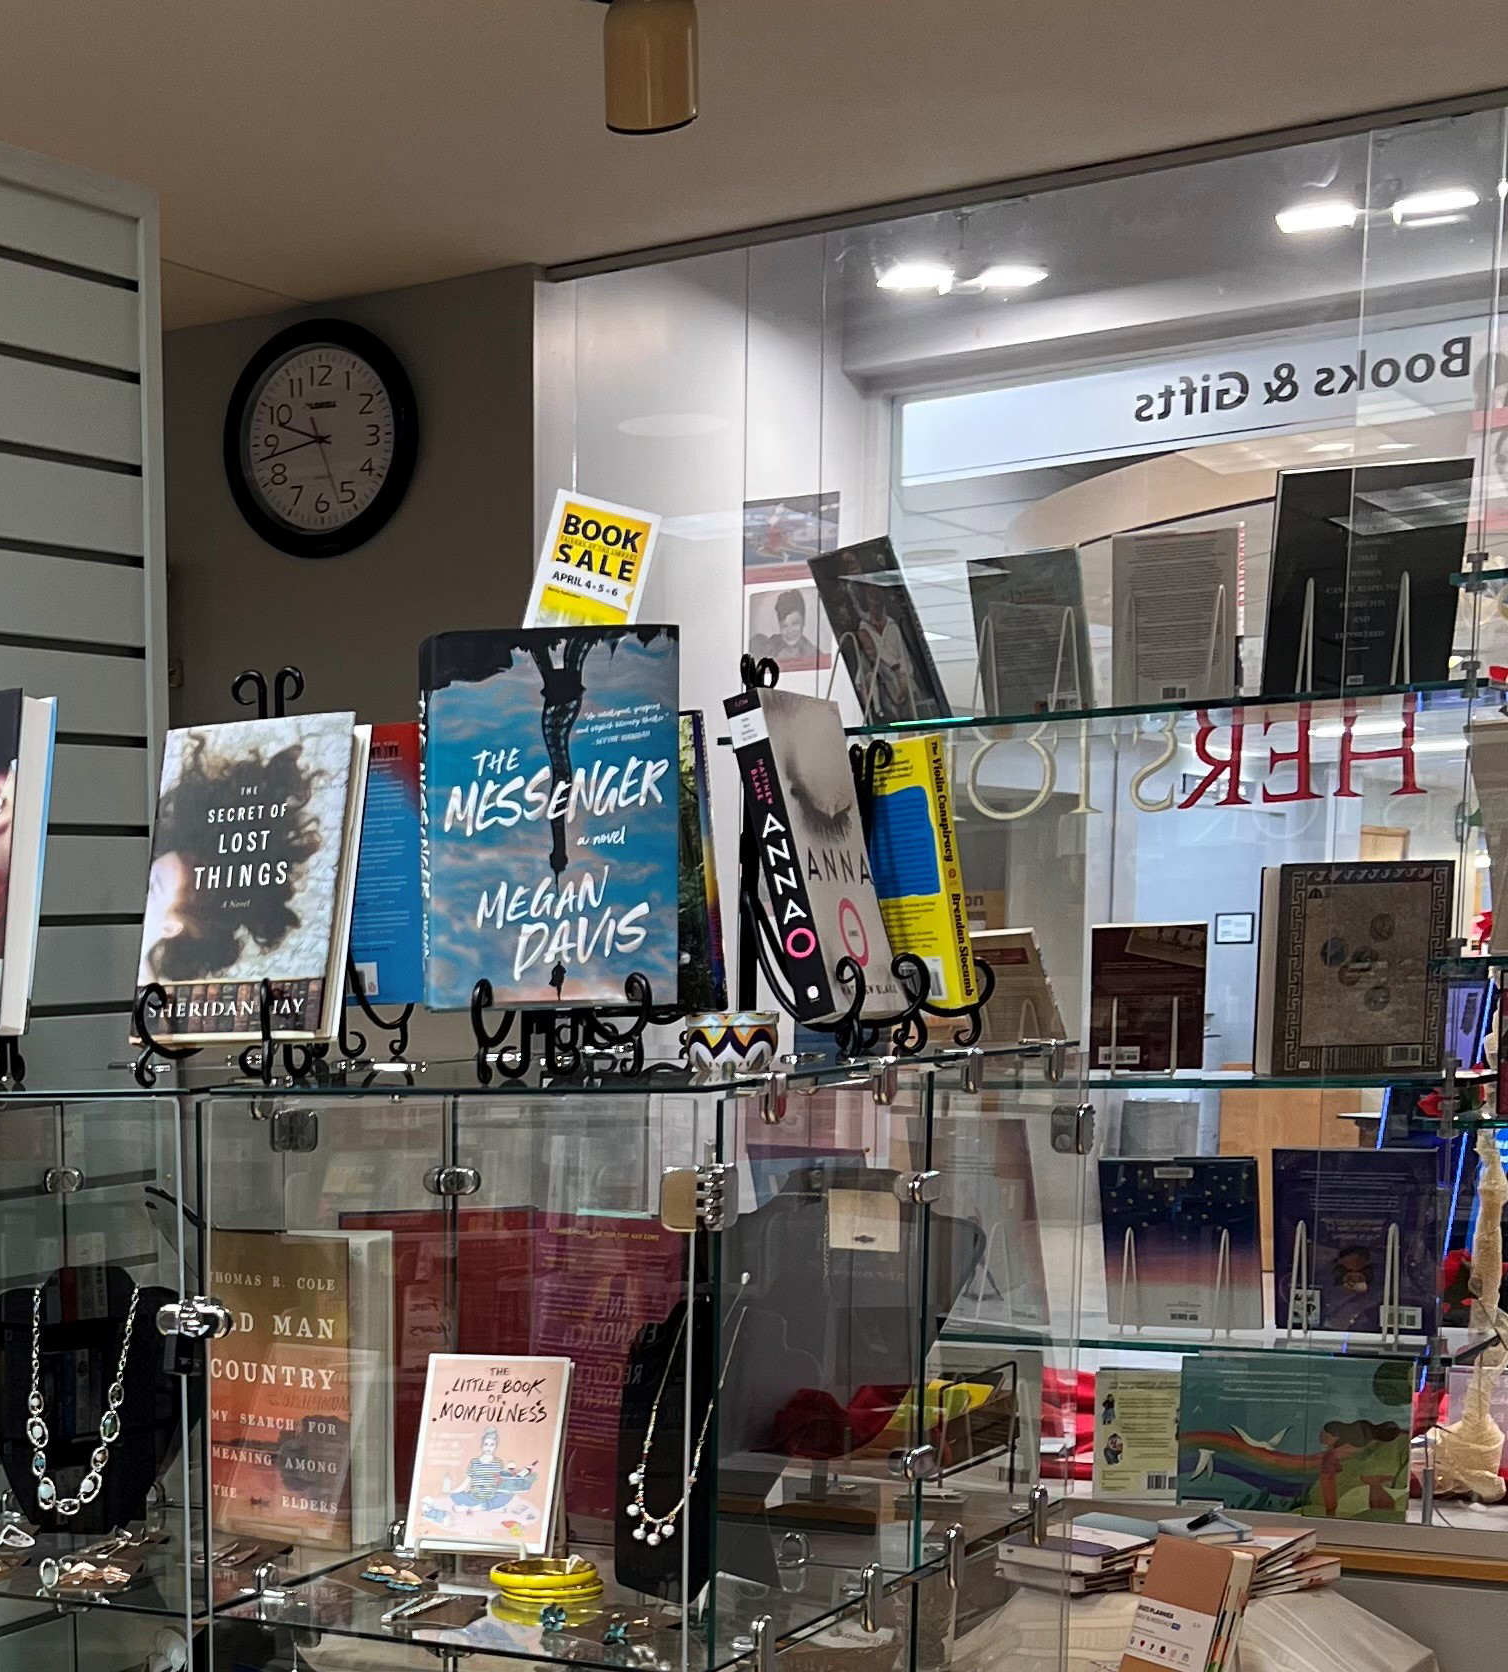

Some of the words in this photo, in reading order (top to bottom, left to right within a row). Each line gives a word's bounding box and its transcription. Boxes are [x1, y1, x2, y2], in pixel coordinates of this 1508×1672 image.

[310, 365, 332, 386] 12
[358, 393, 374, 414] 2
[365, 424, 380, 445] 3
[315, 493, 330, 513] 6
[563, 513, 643, 553] BOOK
[556, 543, 635, 583] SALE
[552, 571, 582, 587] APRIL
[931, 741, 940, 756] The
[472, 748, 520, 777] THE
[932, 758, 945, 793] Violin
[444, 756, 669, 836] MESSENGER
[208, 806, 264, 823] SECRET
[271, 803, 288, 818] OF
[593, 826, 626, 845] novel
[936, 795, 955, 863] Conspiracy
[218, 831, 270, 855] LOST
[194, 861, 288, 890] THINGS
[808, 847, 874, 886] ANNA
[477, 865, 609, 928] MEGAN
[951, 893, 967, 944] Brendan
[513, 901, 650, 981] DAVIS
[958, 946, 974, 996] Slocumb
[148, 999, 255, 1018] SHERIDAN
[296, 1277, 336, 1291] COLE
[273, 1315, 335, 1340] MAN
[210, 1359, 337, 1392] COUNTRY
[490, 1367, 511, 1376] THE
[451, 1378, 497, 1394] LITTLE
[502, 1378, 546, 1395] BOOK
[211, 1409, 228, 1422] MY
[239, 1412, 295, 1431] SEARCH
[308, 1421, 337, 1436] FOR
[439, 1400, 547, 1423] MOMFULNESS
[211, 1446, 272, 1466] MEANING
[284, 1457, 337, 1475] AMONG
[212, 1483, 237, 1499] THE
[281, 1495, 338, 1514] ELDERS
